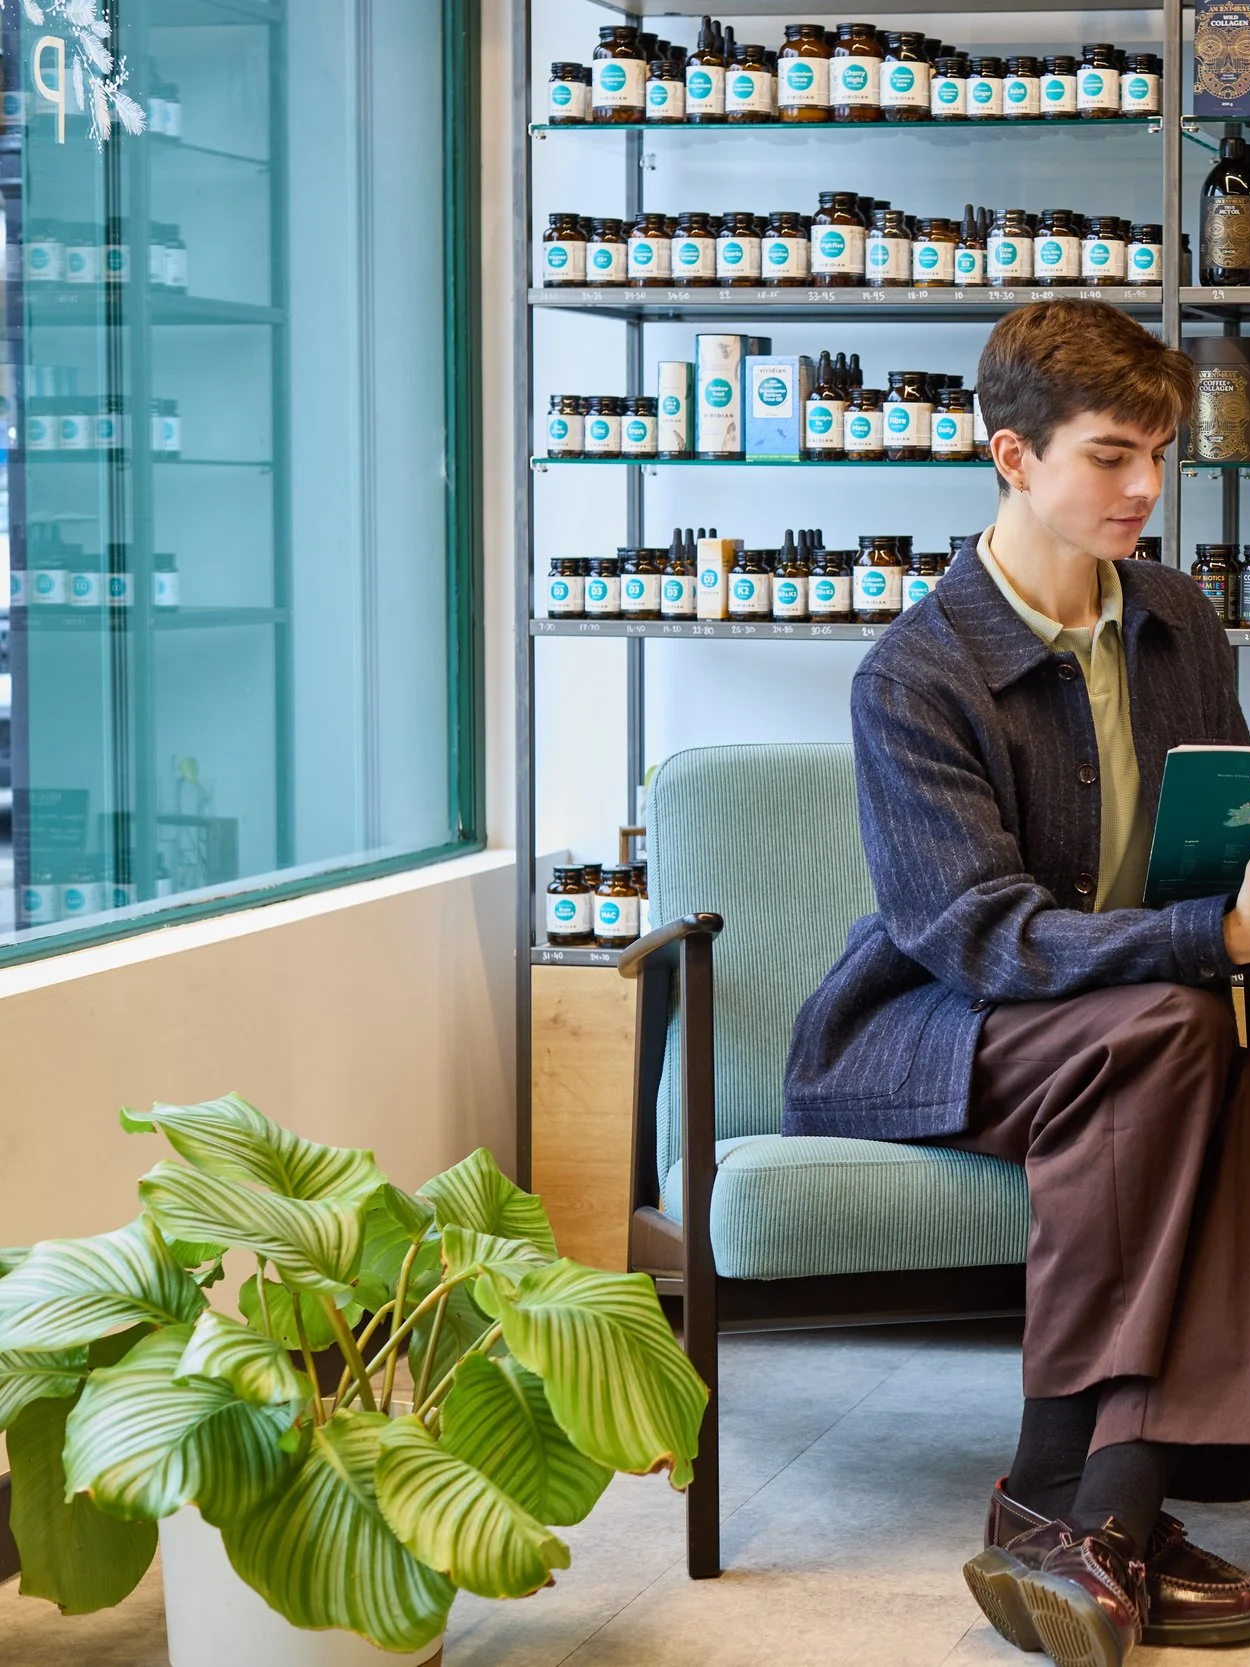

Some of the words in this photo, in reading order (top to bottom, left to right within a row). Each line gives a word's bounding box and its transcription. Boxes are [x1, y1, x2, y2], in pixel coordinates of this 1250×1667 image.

[1212, 290, 1224, 300] 29
[553, 587, 564, 595] D3
[591, 587, 602, 595] D3
[629, 585, 639, 593] D3
